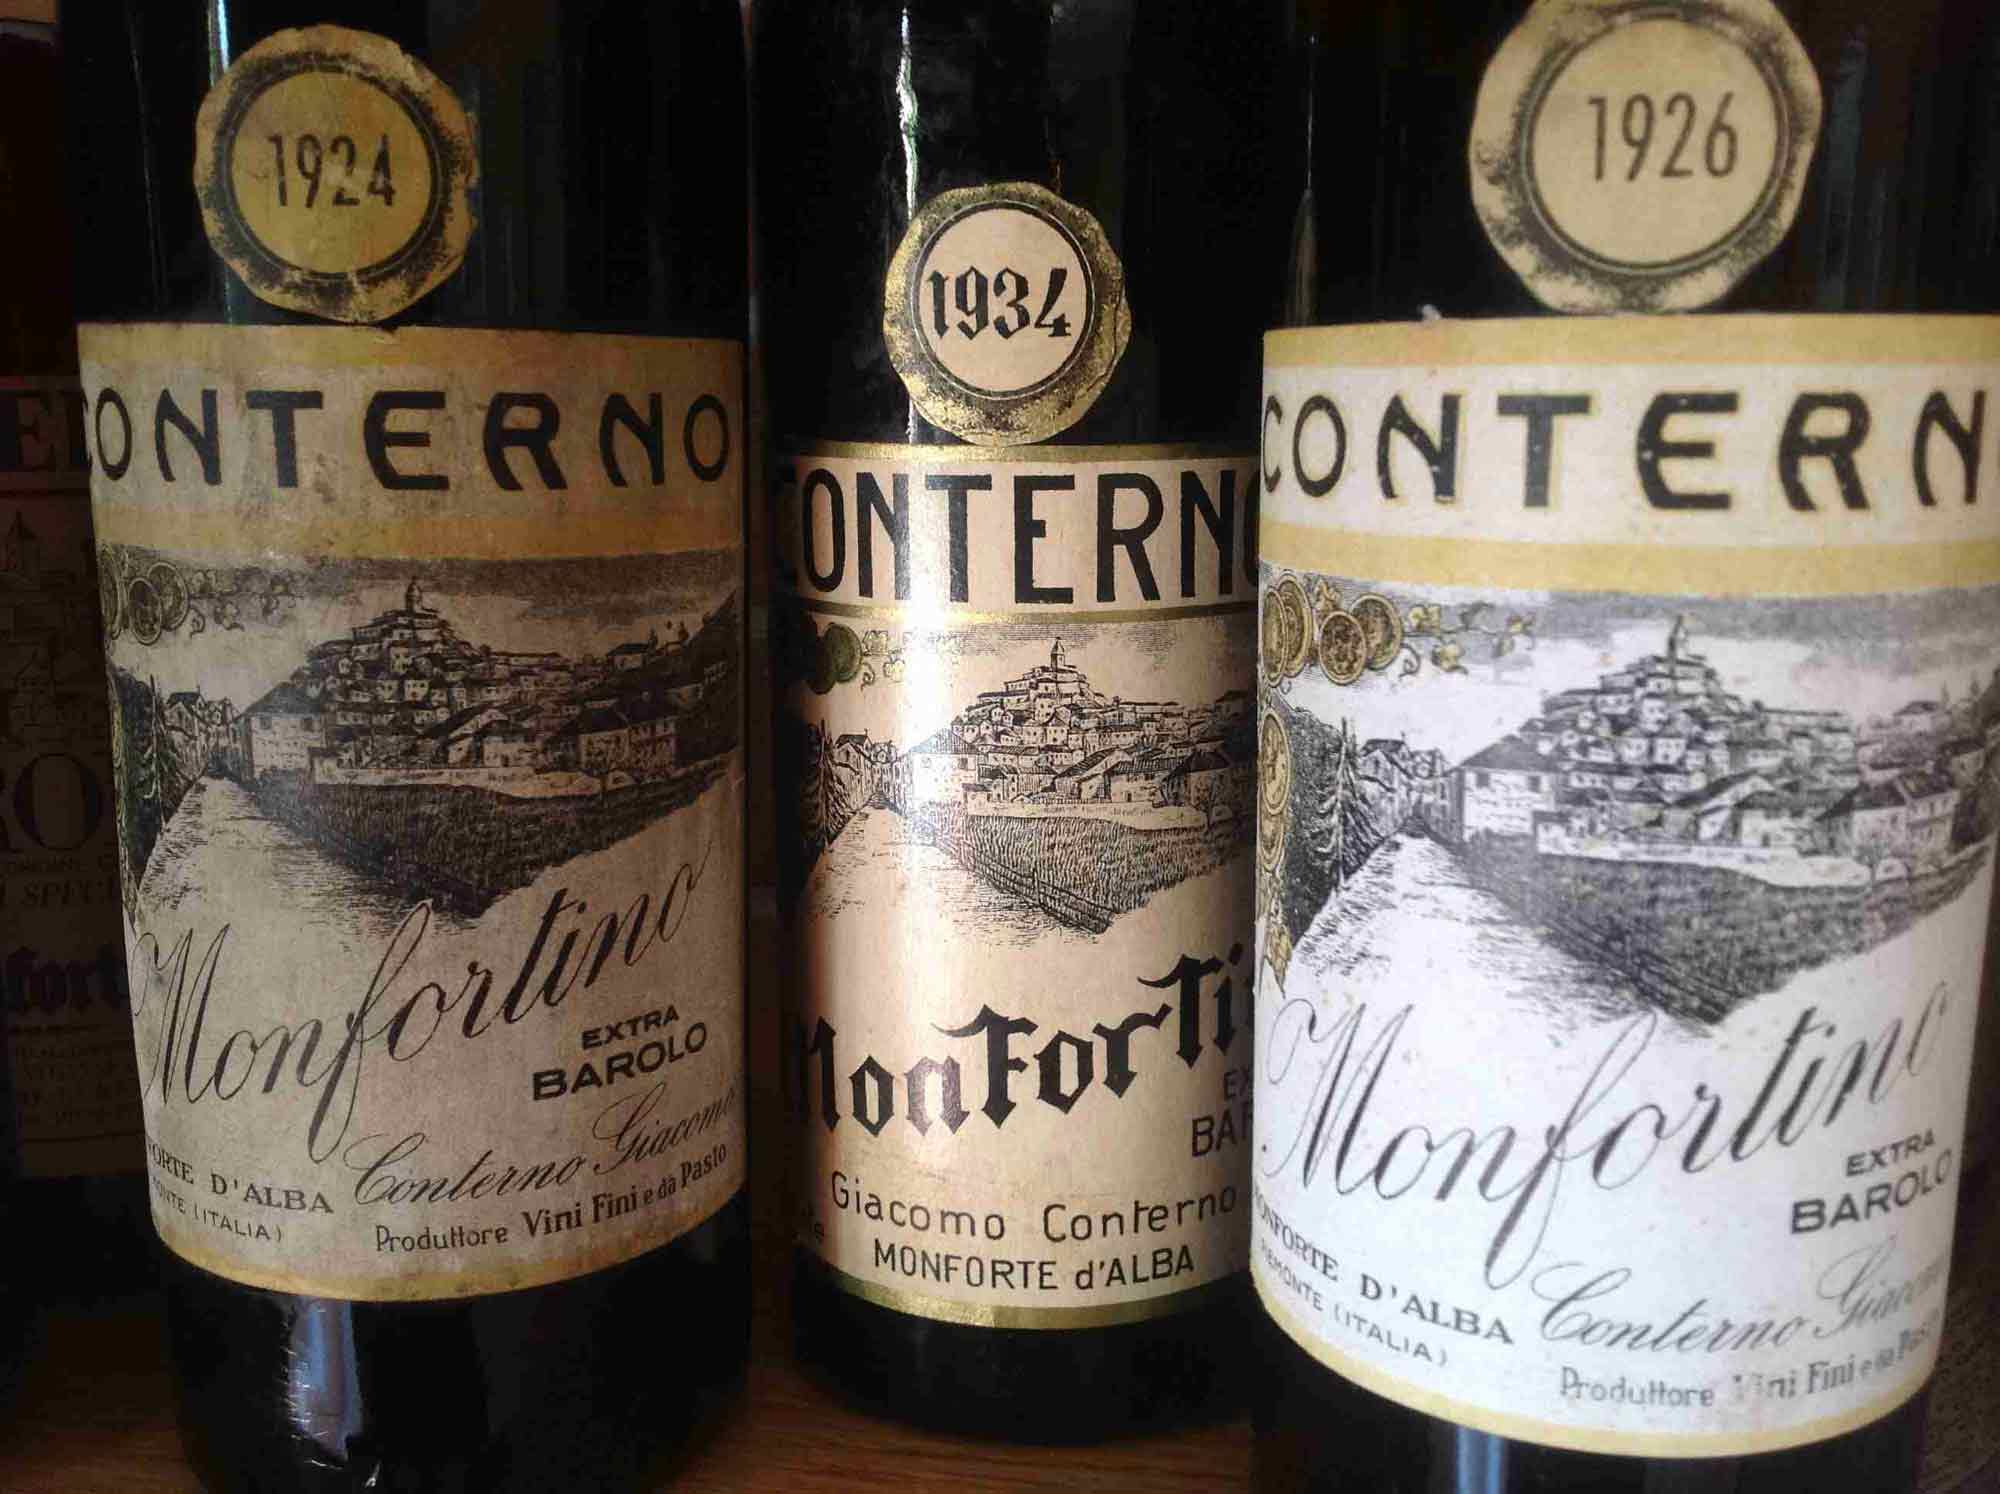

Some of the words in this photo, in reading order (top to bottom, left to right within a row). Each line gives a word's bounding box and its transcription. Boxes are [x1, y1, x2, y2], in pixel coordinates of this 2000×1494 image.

[267, 133, 396, 209] 1924
[1588, 91, 1738, 182] 1926
[925, 265, 1072, 341] 1934
[84, 387, 730, 492] ONTERNO
[134, 840, 712, 1163] Monfortino
[580, 1004, 680, 1050] EXTRA
[532, 1021, 708, 1101] BAROLO
[342, 1131, 588, 1205] Conterno
[1265, 980, 1948, 1291] Monfortino
[1845, 1128, 1936, 1178] EXTRA
[149, 1143, 195, 1185] ORTE
[210, 1173, 335, 1215] D'ALBA
[376, 1224, 509, 1253] Produttore
[521, 1202, 583, 1238] Vini
[592, 1184, 638, 1224] Fini
[680, 1143, 728, 1189] Pasto
[831, 1169, 1007, 1241] Giacomo
[1042, 1185, 1237, 1243] Conterno
[1790, 1148, 1953, 1235] BAROLO
[194, 1206, 283, 1243] (ITALIA)
[873, 1238, 1059, 1291] MONFORTE
[1075, 1244, 1195, 1292] d'ALBA
[1332, 1303, 1448, 1367] (ITALIA)
[1359, 1273, 1515, 1345] D'ALBA
[1530, 1262, 1810, 1353] Conterno
[1561, 1366, 1715, 1407] Produttore
[1808, 1353, 1856, 1394] Fini
